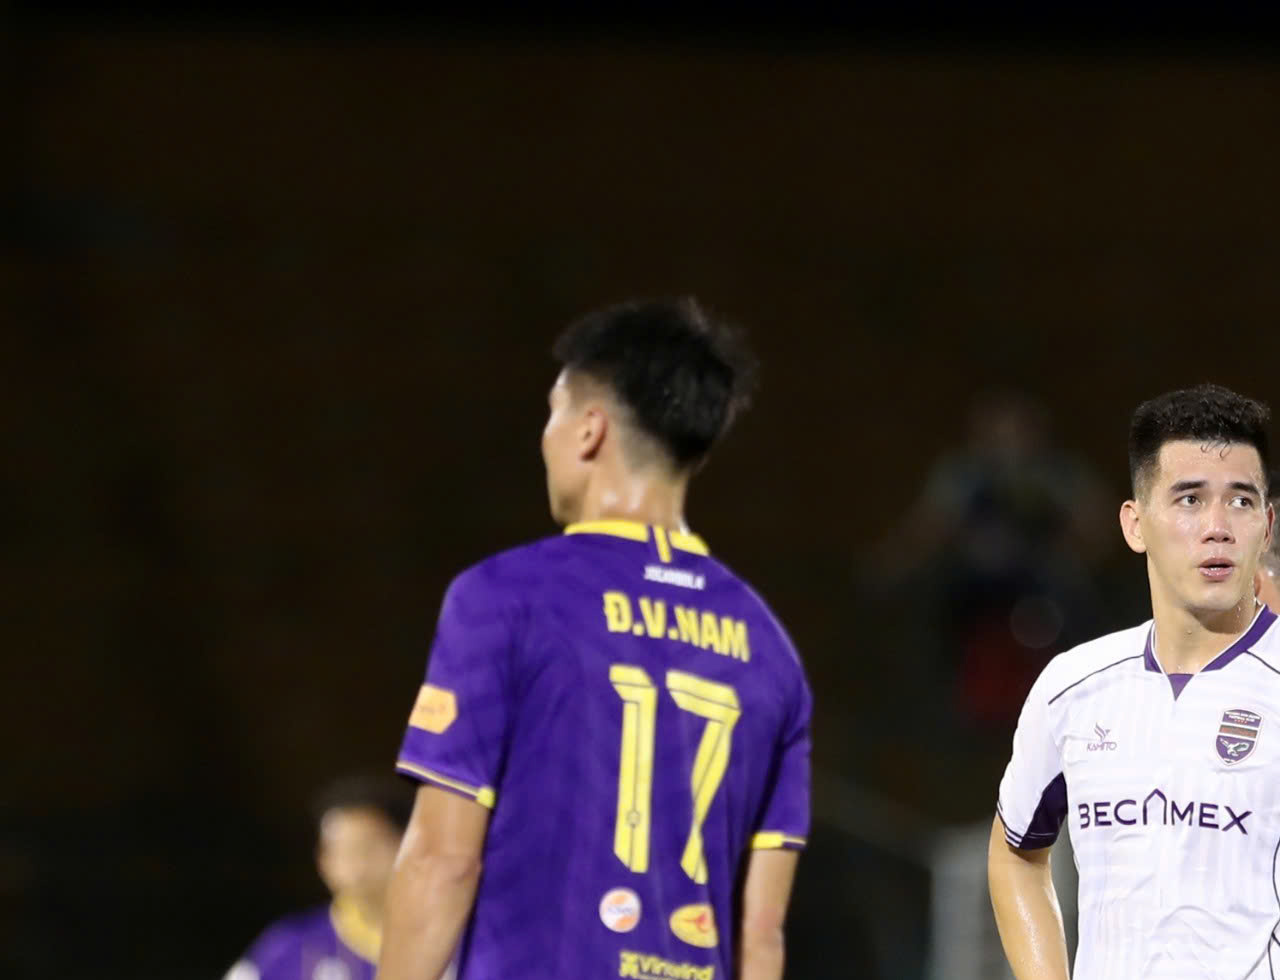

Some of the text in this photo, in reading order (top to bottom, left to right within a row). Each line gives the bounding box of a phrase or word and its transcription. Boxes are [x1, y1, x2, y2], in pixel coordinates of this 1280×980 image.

[603, 591, 750, 663] Đ.V.NAM
[609, 664, 741, 885] 17
[1078, 788, 1253, 835] BECAMEX
